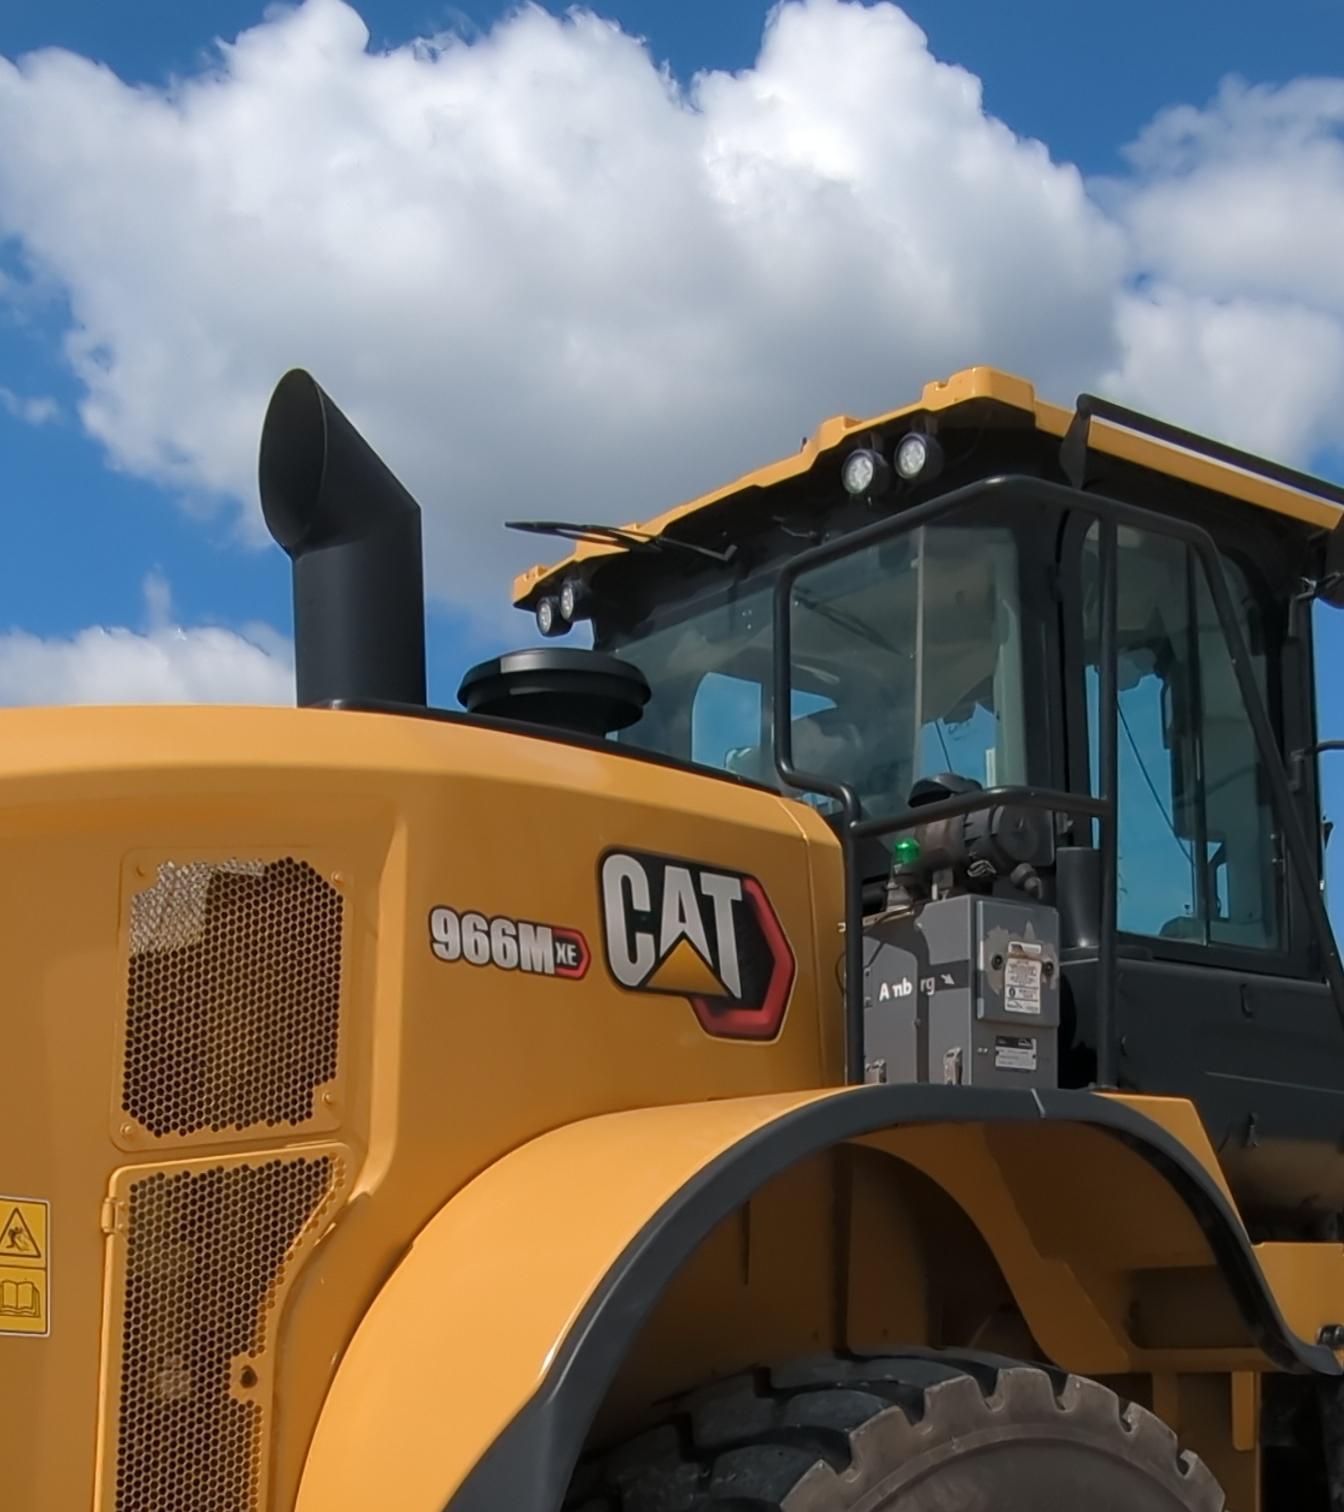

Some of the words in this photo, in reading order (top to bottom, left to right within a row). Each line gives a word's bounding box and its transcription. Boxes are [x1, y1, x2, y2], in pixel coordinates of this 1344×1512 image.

[431, 907, 556, 975] 966M
[556, 942, 577, 966] XE
[602, 854, 742, 999] CAT
